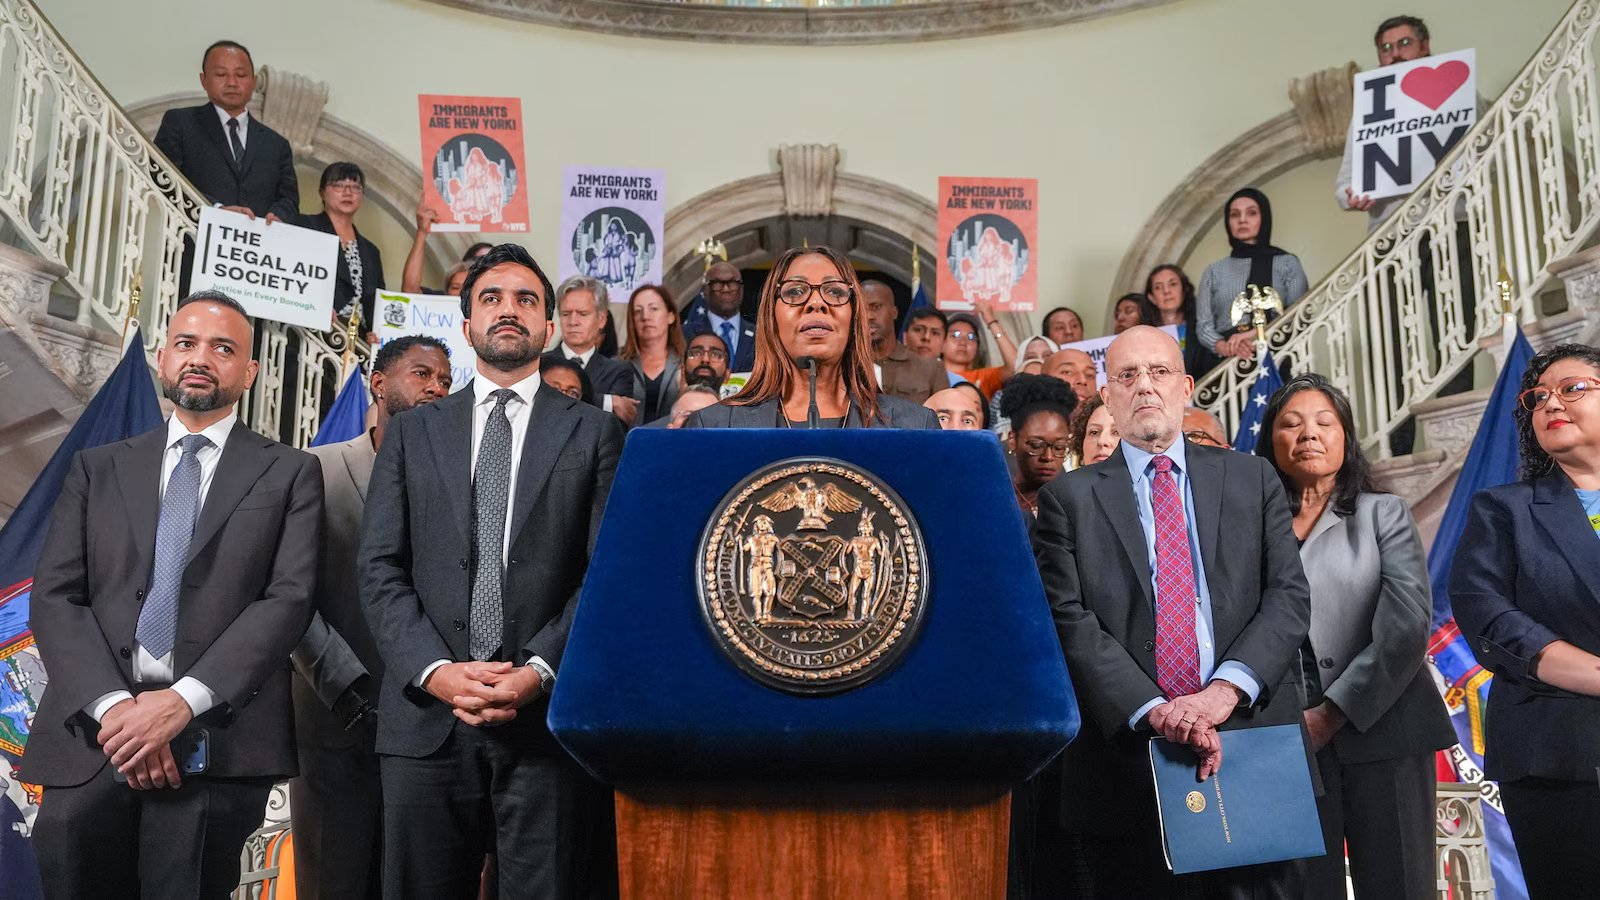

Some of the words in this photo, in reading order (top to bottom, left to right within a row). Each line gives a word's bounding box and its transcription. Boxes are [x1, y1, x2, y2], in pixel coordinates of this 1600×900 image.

[1363, 74, 1396, 125] I
[433, 104, 508, 118] IMMIGRANTS
[429, 117, 451, 128] ARE
[454, 118, 480, 129] NEW
[482, 119, 517, 130] YORK!
[1356, 107, 1474, 142] IMMIGRANT
[1362, 124, 1471, 192] NY
[577, 174, 652, 188] IMMIGRANTS
[952, 185, 1025, 198] IMMIGRANTS
[570, 186, 592, 198] ARE
[595, 187, 621, 199] NEW
[624, 188, 658, 201] YORK!
[946, 197, 968, 208] ARE
[971, 198, 996, 209] NEW
[998, 199, 1032, 210] YORK!
[219, 225, 261, 247] THE
[216, 244, 287, 272] LEGAL
[293, 261, 328, 280] AID
[214, 263, 309, 295] SOCIETY
[212, 283, 242, 295] Justice
[254, 292, 278, 303] Every
[280, 297, 317, 311] Borough.
[412, 304, 454, 328] New
[790, 631, 835, 643] 1625
